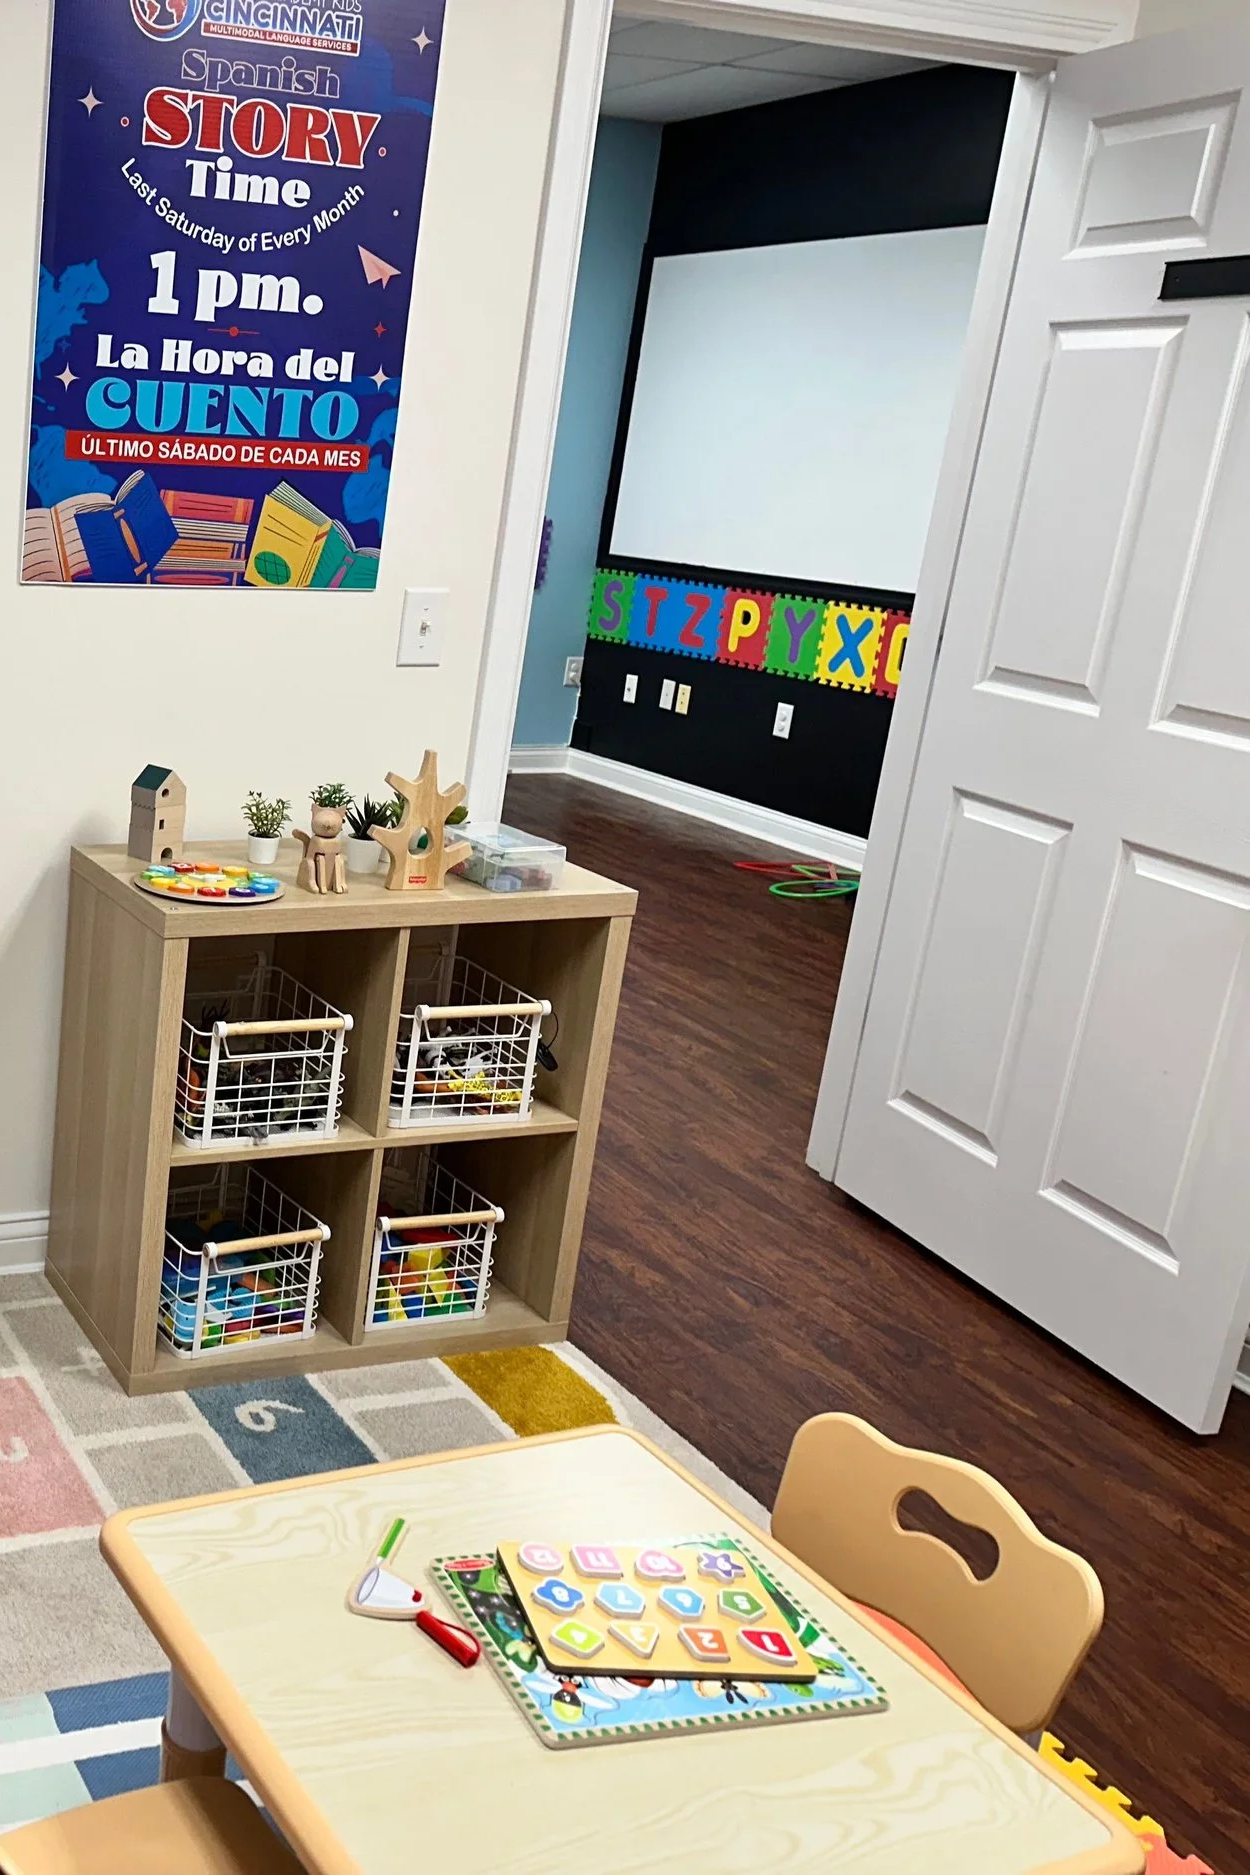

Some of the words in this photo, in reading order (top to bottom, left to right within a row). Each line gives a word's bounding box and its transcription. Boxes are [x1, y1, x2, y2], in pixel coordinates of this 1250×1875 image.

[204, 0, 363, 41] CINCINNATI
[209, 24, 265, 40] MULTIMODAL
[266, 32, 312, 47] LANGUAGE
[312, 38, 352, 51] SERVICES
[181, 48, 340, 98] Spanish
[141, 86, 381, 169] STORY
[121, 157, 157, 205] Last
[154, 197, 234, 254] Saturday
[238, 233, 257, 252] of
[261, 224, 311, 251] Every
[312, 184, 365, 233] Month
[185, 156, 311, 208] Time
[148, 251, 179, 314] 1
[194, 269, 324, 322] pm.
[96, 334, 149, 371] La
[160, 338, 274, 378] Hora
[284, 350, 355, 383] del
[85, 376, 359, 441] CUENTO
[80, 433, 153, 458] ÚLTIMO
[158, 438, 236, 463] SÁBADO
[240, 445, 265, 464] DE
[269, 446, 320, 466] CADA
[324, 449, 361, 468] MES
